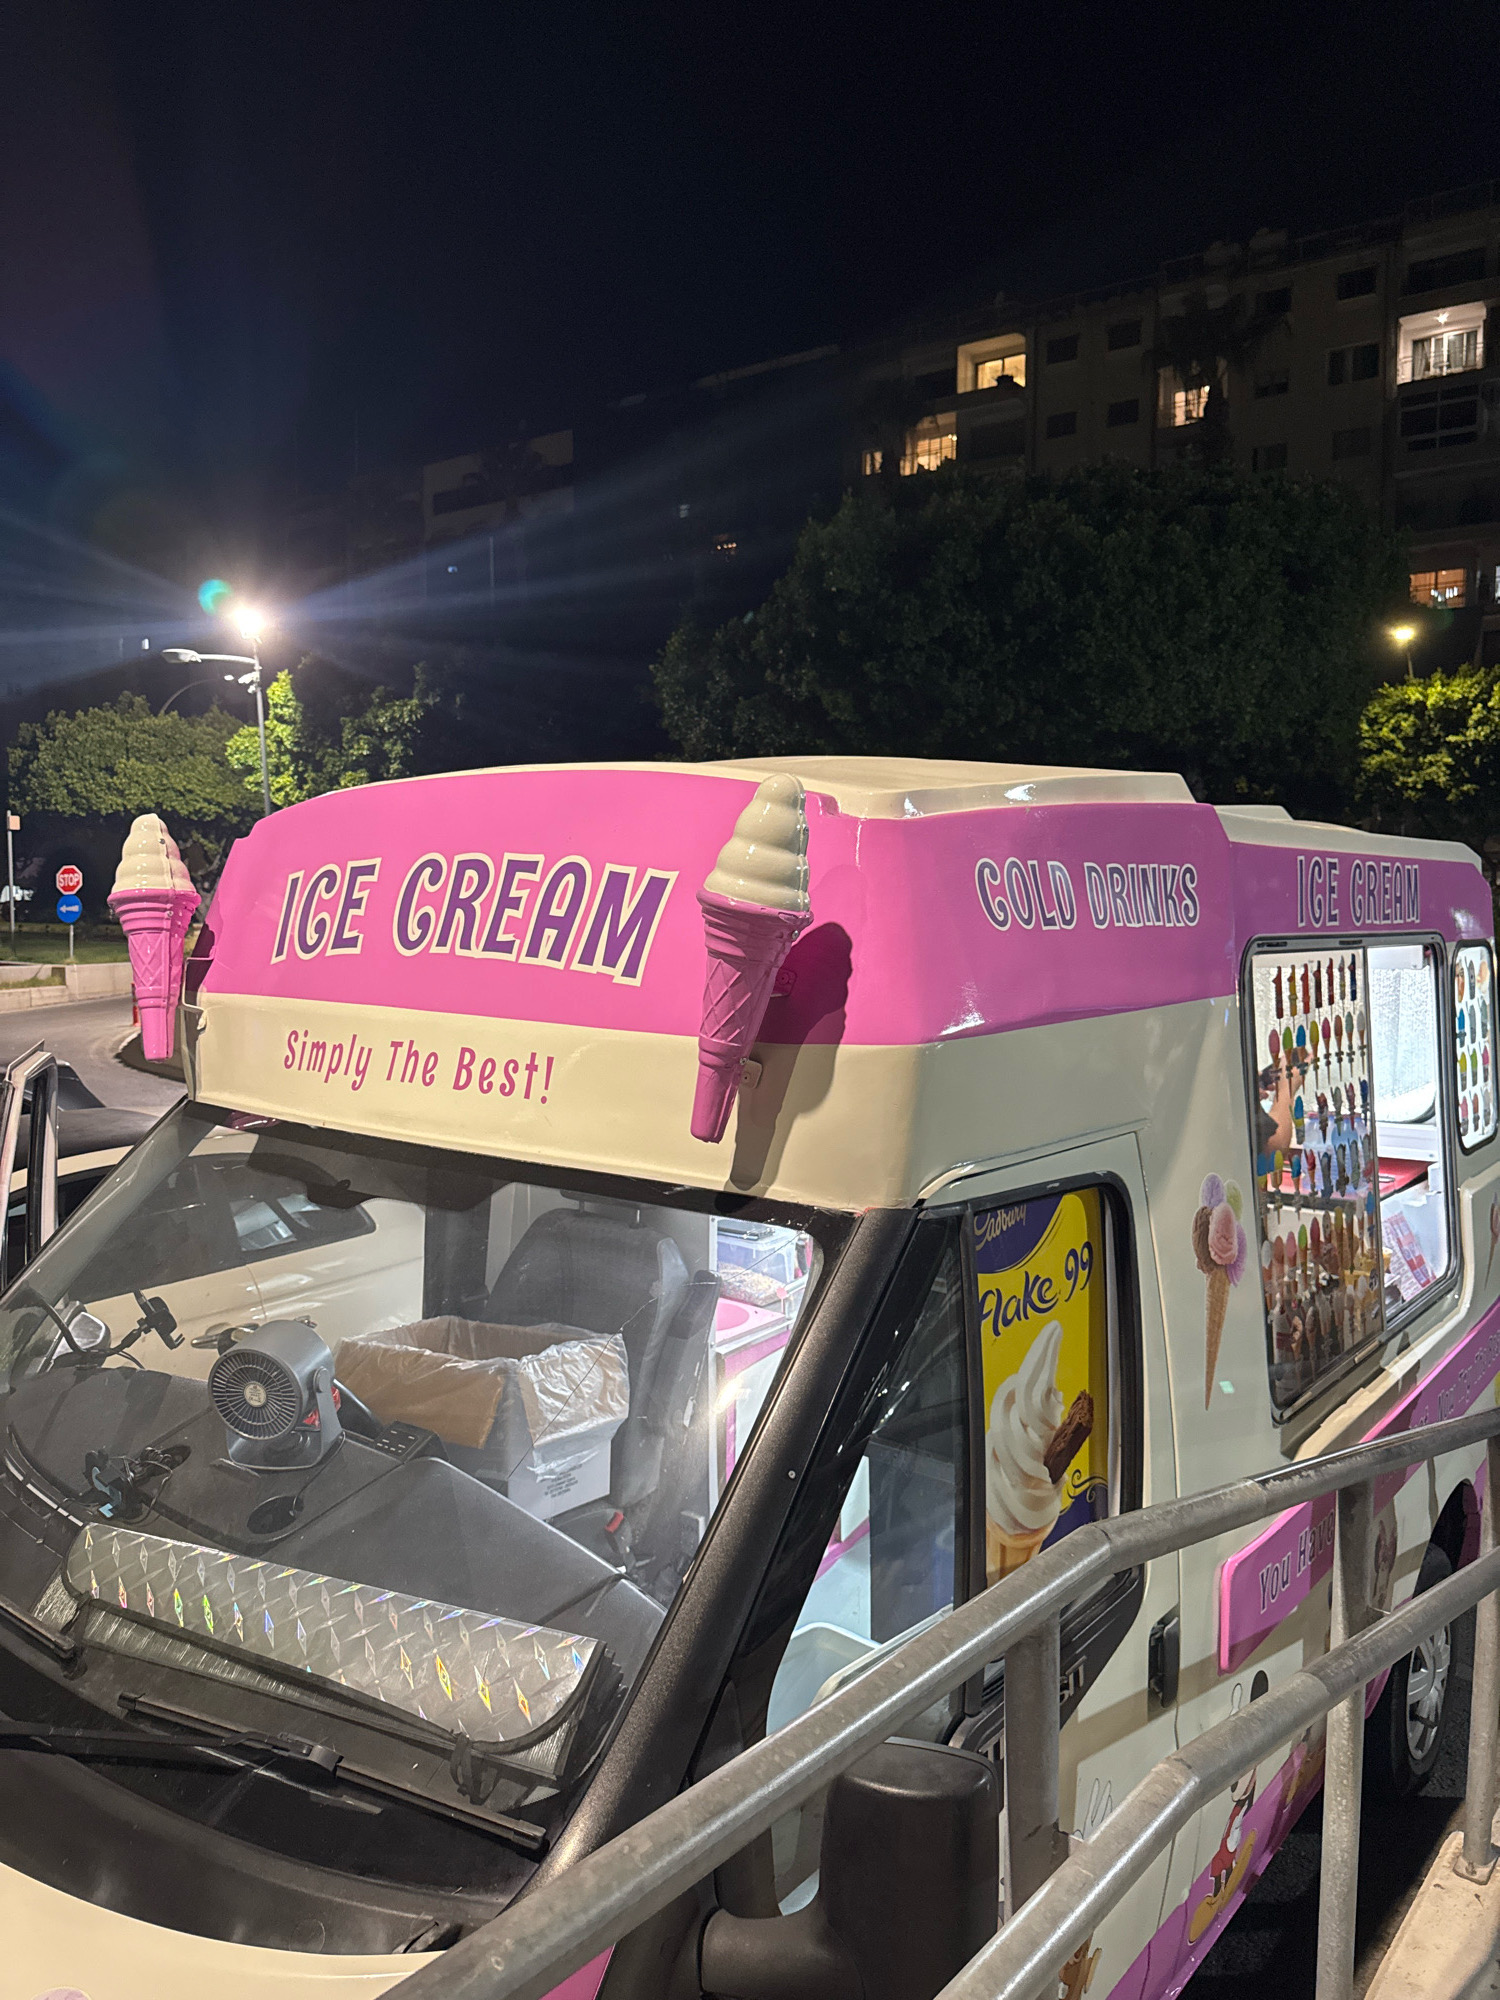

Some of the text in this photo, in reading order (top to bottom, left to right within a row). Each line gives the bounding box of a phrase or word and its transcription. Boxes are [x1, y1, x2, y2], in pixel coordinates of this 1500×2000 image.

[59, 873, 80, 887] STOP
[975, 857, 1199, 931] COLD DRINKS
[1297, 856, 1421, 928] ICE CREAM
[270, 852, 680, 987] ICE CREAM
[284, 1029, 555, 1104] Simply The Best!
[1064, 1241, 1093, 1302] 99
[1259, 1551, 1292, 1615] You
[1296, 1508, 1335, 1578] Have
